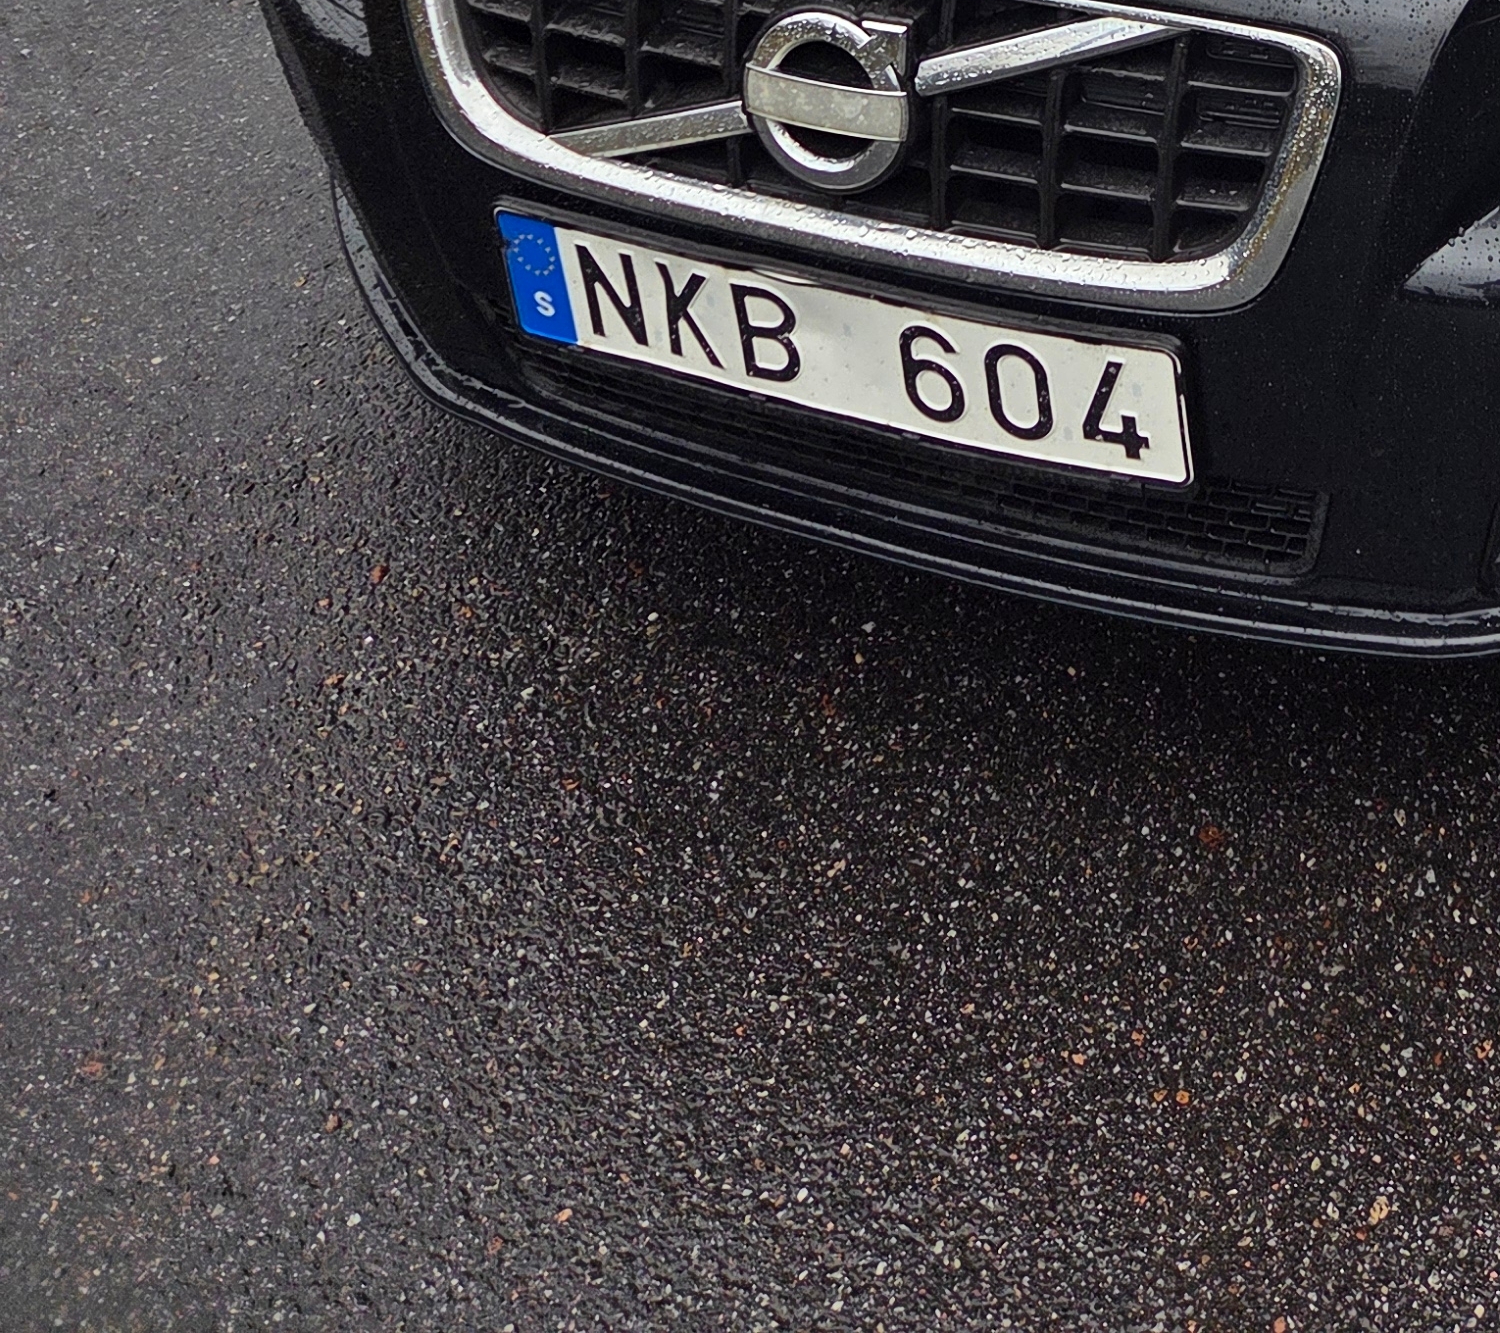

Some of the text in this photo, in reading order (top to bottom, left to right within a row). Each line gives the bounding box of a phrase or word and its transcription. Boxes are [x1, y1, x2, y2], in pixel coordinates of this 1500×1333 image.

[533, 290, 556, 318] S
[574, 243, 1150, 461] NKB 604
